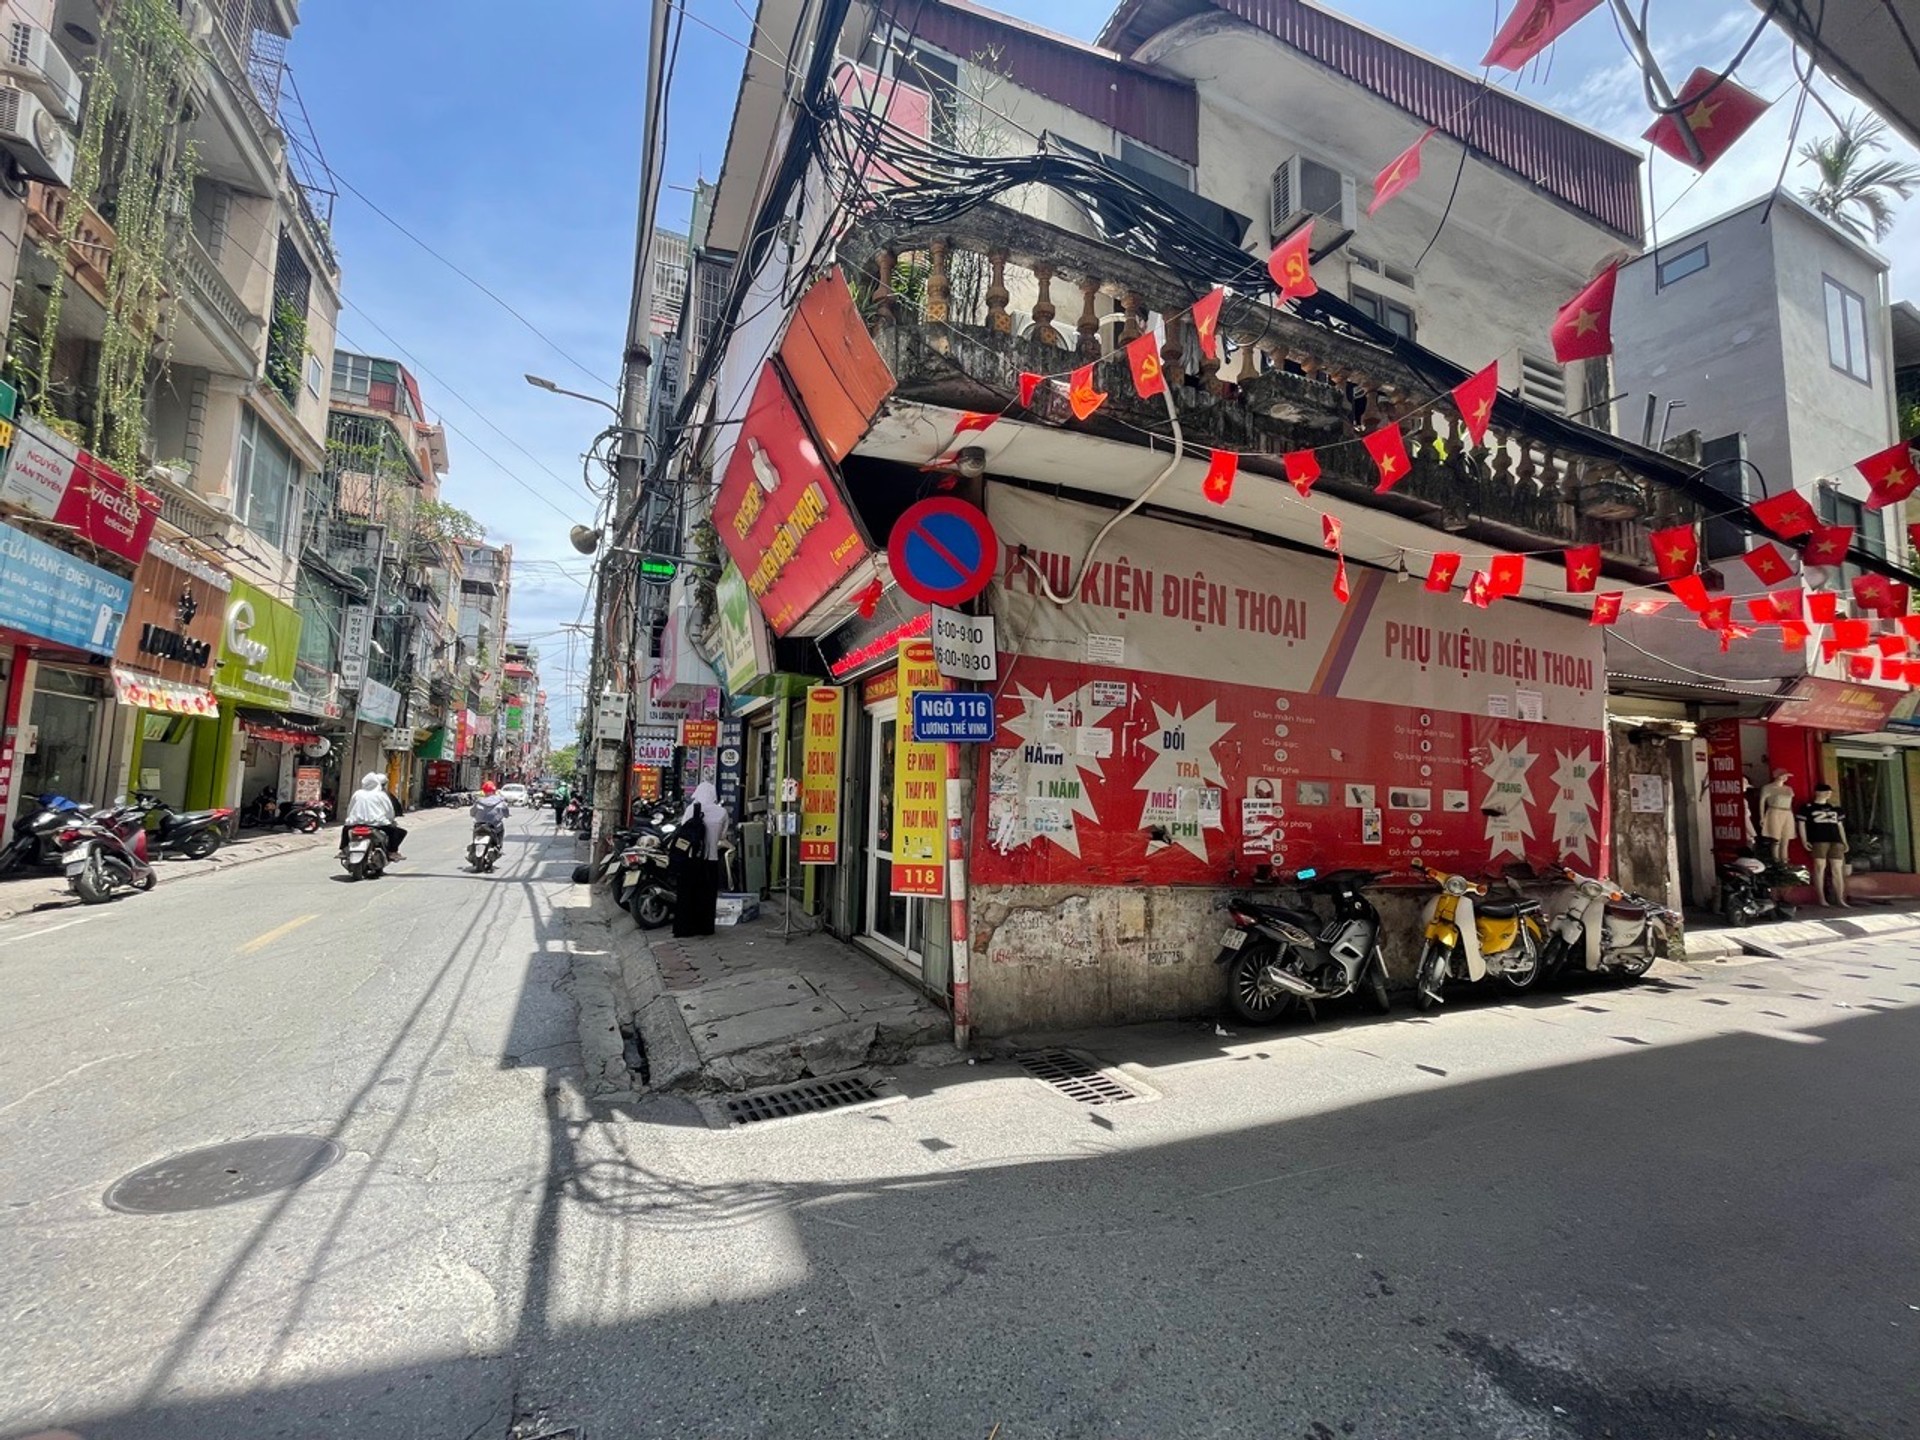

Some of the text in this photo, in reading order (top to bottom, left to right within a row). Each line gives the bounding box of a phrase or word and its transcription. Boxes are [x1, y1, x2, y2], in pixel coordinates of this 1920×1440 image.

[1004, 544, 1307, 648] PHỤ KIỆN ĐIỆN THOẠI
[937, 619, 983, 644] 6:00-9:00
[1385, 620, 1593, 696] PHỤ KIỆN ĐIỆN THOẠI
[921, 697, 954, 717] NGÕ
[959, 701, 987, 717] 116
[921, 719, 988, 735] LƯƠNG THẾ VINH
[1163, 724, 1185, 751] ĐỔI
[1176, 758, 1201, 778] TRẢ
[905, 782, 937, 799] THAY PIN
[1037, 777, 1080, 799] 1 NĂM
[1710, 780, 1741, 794] TRANG
[903, 810, 920, 828] THAY
[1811, 811, 1838, 823] 23
[1171, 821, 1198, 837] PHÍ
[808, 844, 830, 855] 118
[905, 868, 936, 884] 118
